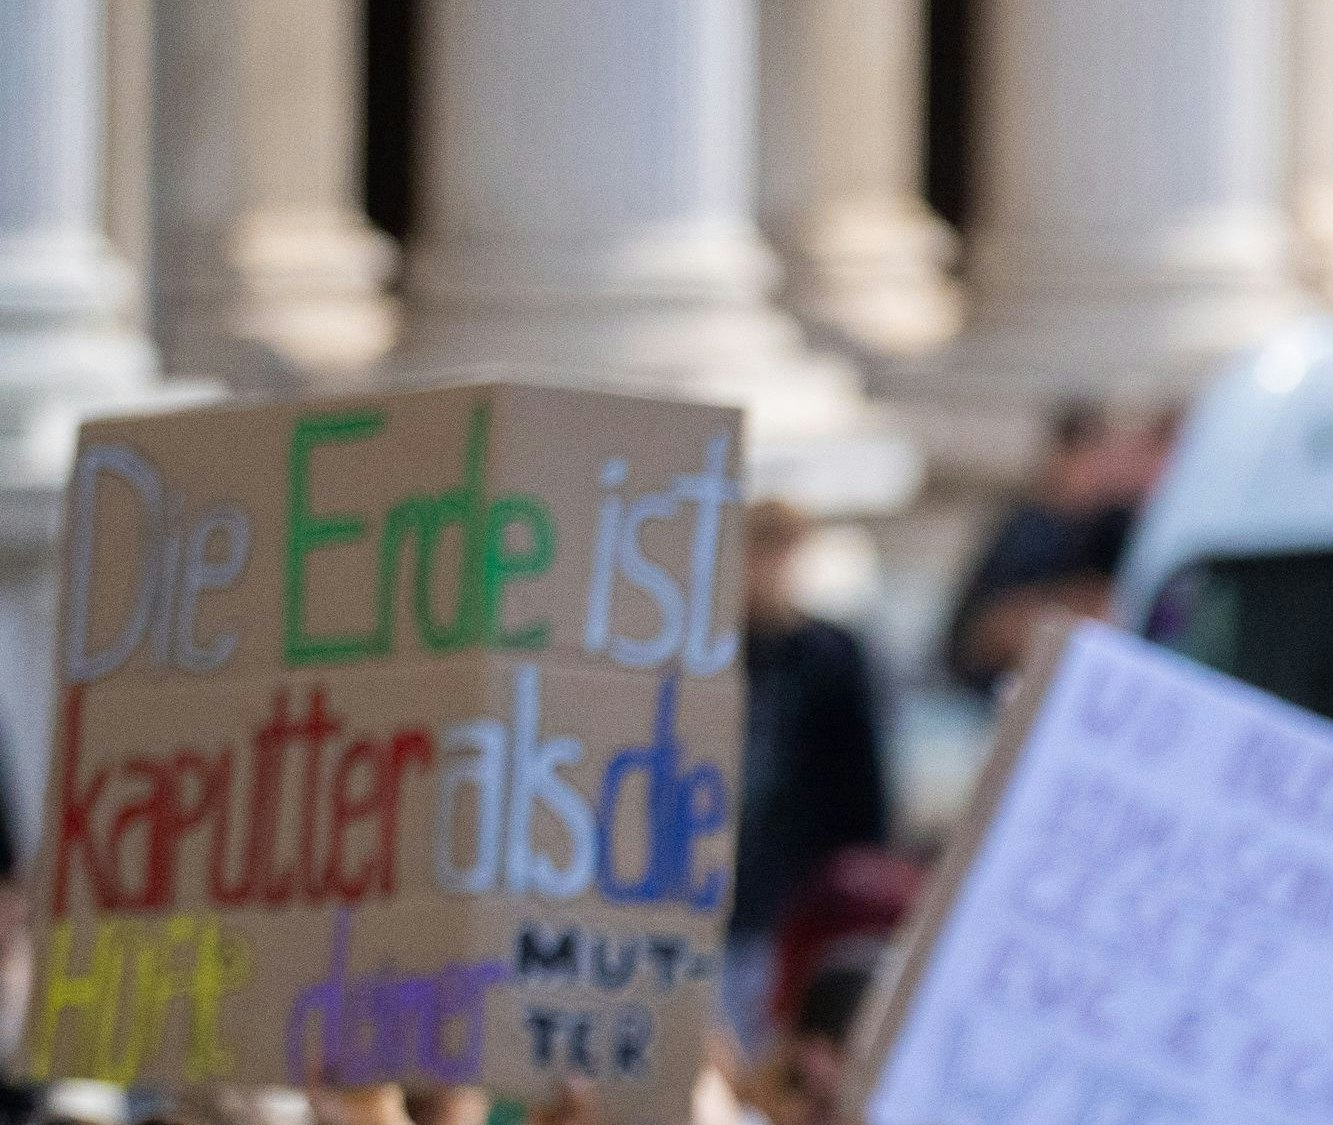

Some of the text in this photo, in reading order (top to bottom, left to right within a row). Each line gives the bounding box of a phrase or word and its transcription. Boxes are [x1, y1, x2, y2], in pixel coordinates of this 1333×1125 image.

[64, 402, 745, 684] Die Erde ist
[52, 683, 434, 922] kaputter
[434, 666, 595, 900] als
